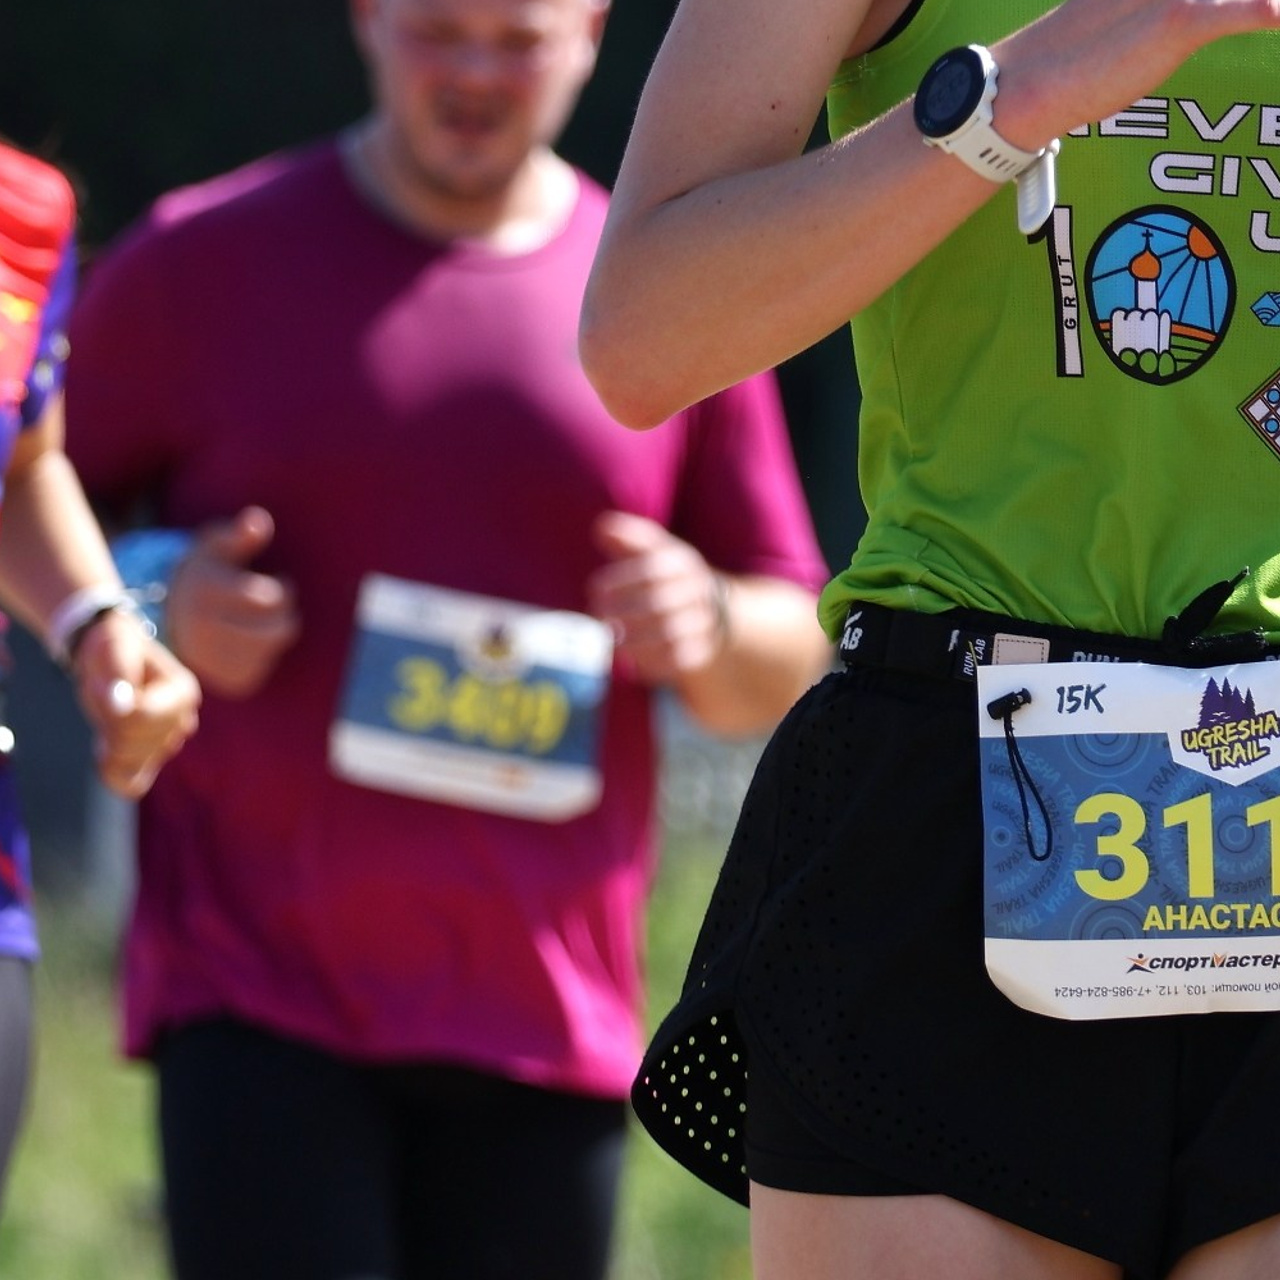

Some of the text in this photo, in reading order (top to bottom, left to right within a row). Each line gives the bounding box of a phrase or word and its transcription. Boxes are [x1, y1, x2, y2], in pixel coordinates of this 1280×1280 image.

[1057, 254, 1077, 330] GRUT
[840, 626, 863, 651] AB
[963, 651, 974, 676] RUN
[1056, 683, 1107, 715] 15K
[1205, 740, 1270, 769] TRAIL
[1055, 986, 1152, 998] +7-985-824-6424
[1156, 985, 1179, 996] 112,
[1184, 984, 1207, 996] 103,
